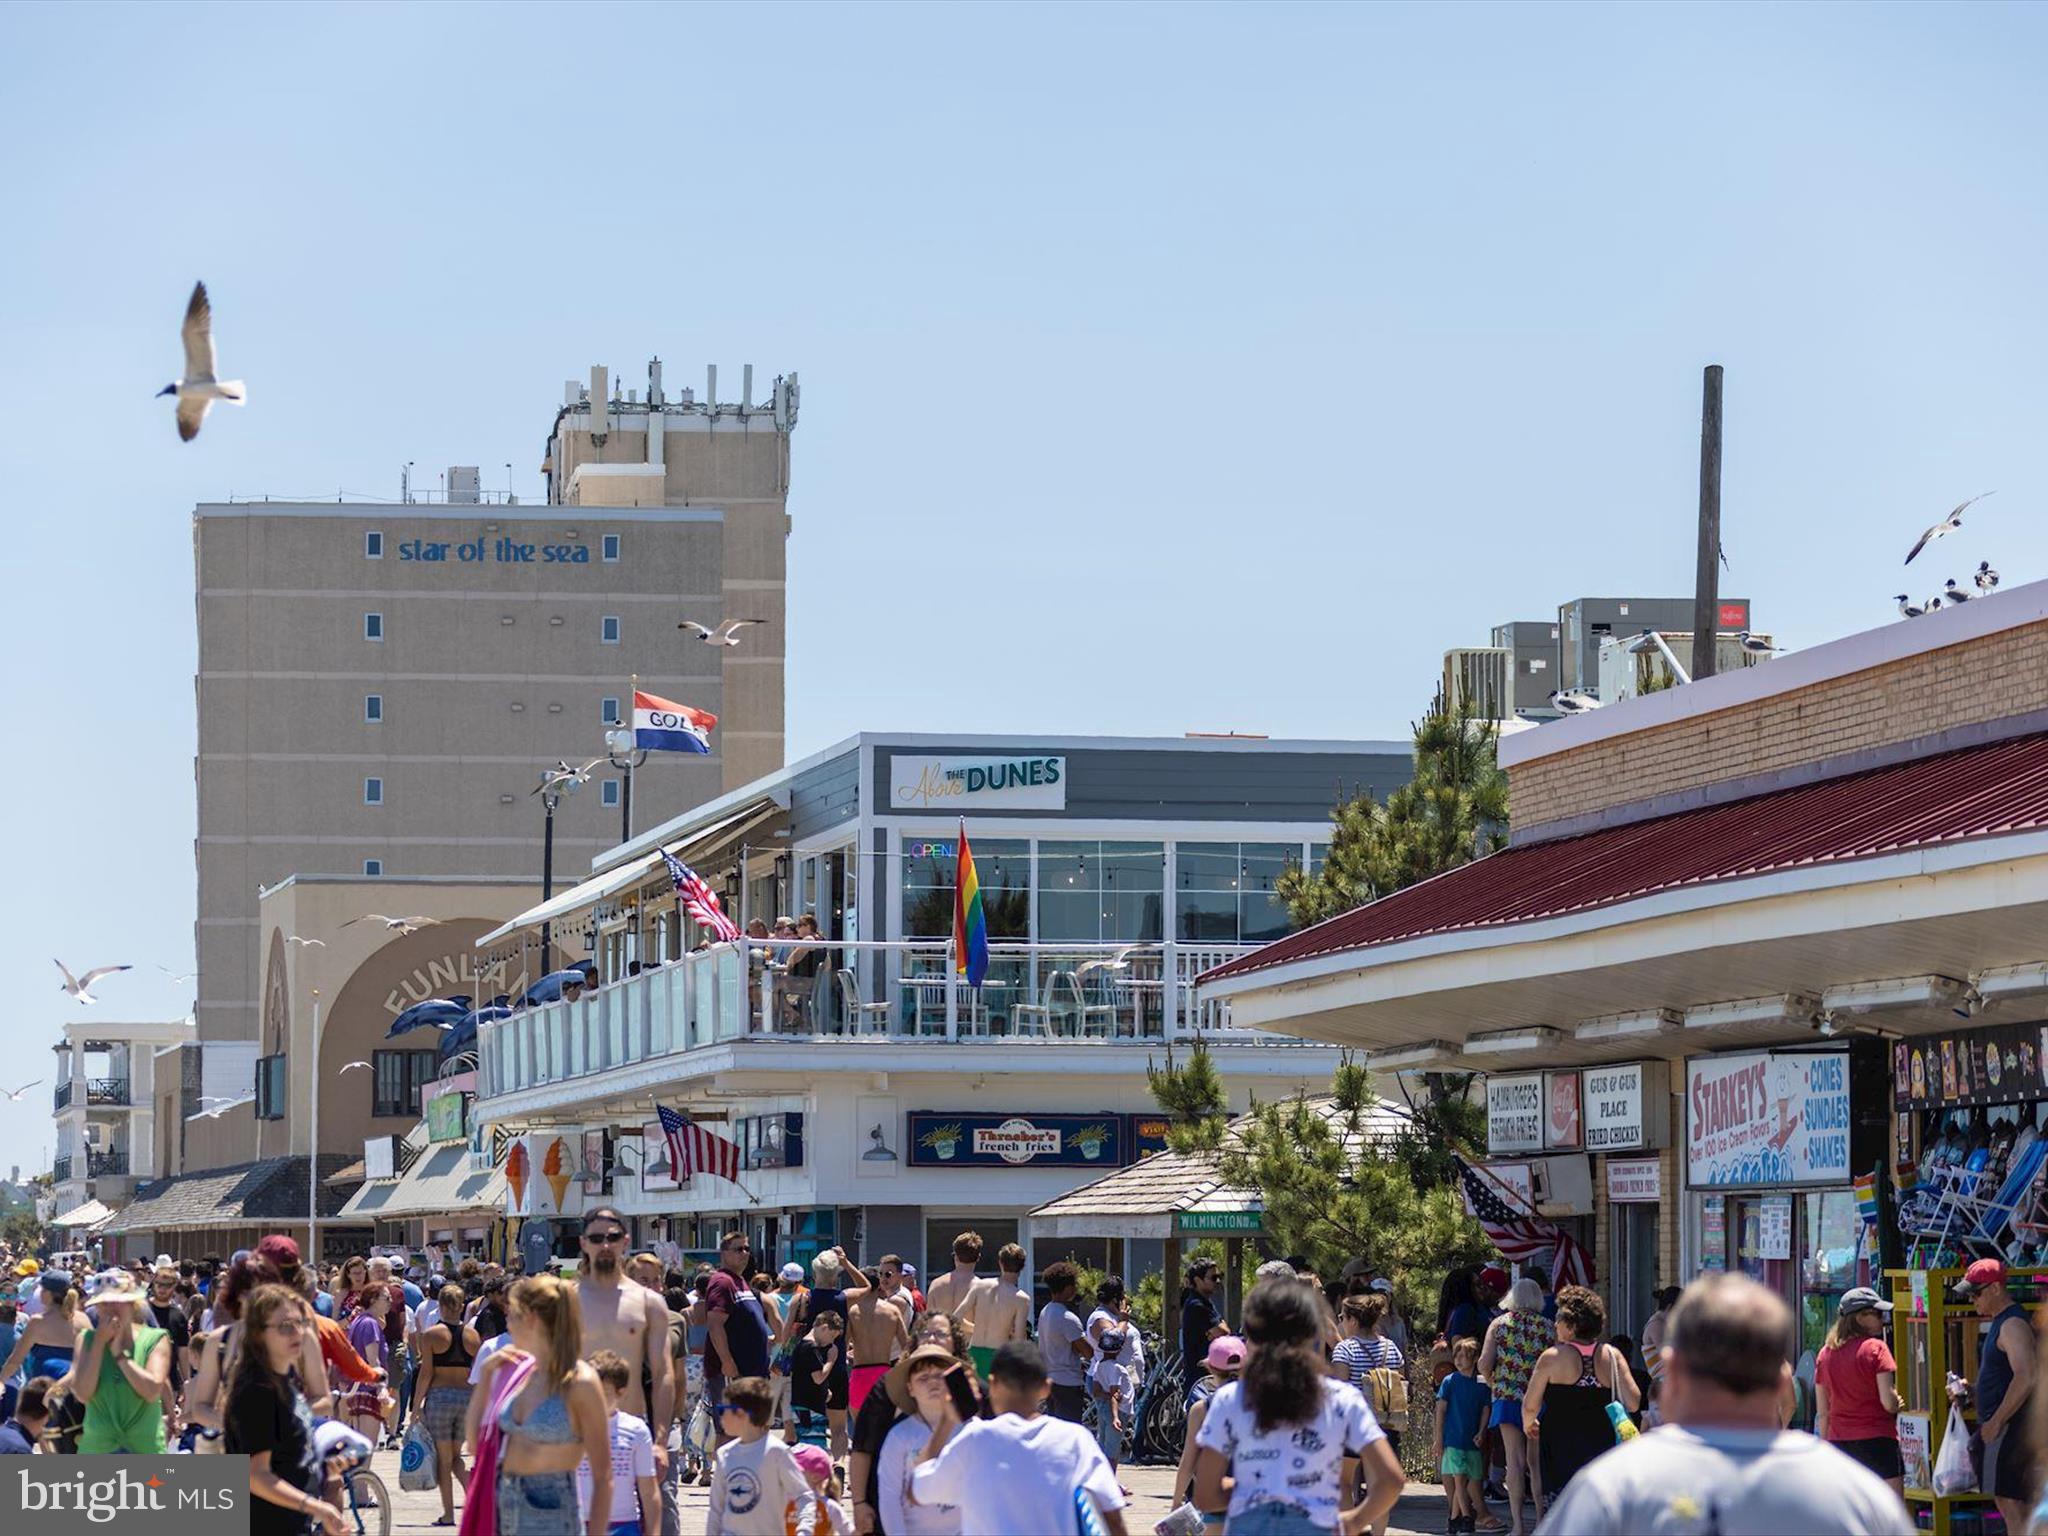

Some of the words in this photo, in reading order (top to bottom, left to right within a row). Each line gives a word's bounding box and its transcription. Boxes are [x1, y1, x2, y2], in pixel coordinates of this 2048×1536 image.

[399, 539, 451, 562] star
[457, 537, 487, 563] of
[495, 537, 536, 563] the
[541, 543, 590, 563] sea
[649, 711, 696, 731] GOL
[898, 762, 963, 807] Above
[946, 769, 966, 781] THE
[967, 758, 1061, 793] DUNES
[911, 843, 952, 859] OPEN
[1590, 1076, 1608, 1094] GUS
[1609, 1075, 1618, 1092] &
[1618, 1073, 1637, 1091] GUS
[1809, 1057, 1843, 1093] CONES
[1599, 1100, 1628, 1118] PLACE
[1692, 1060, 1768, 1142] STARKEY'S
[1804, 1095, 1849, 1131] SUNDAES
[978, 1130, 1057, 1142] Thrasher's
[1587, 1128, 1609, 1146] FRIED
[1609, 1124, 1641, 1144] CHICKEN
[1690, 1146, 1703, 1163] Over
[1705, 1138, 1717, 1158] 100
[1718, 1135, 1728, 1153] Ice
[1729, 1129, 1749, 1149] Cream
[979, 1141, 1019, 1152] french
[1025, 1141, 1055, 1152] fries
[1808, 1135, 1846, 1170] SHAKES
[1181, 1214, 1243, 1229] WILMINGTON
